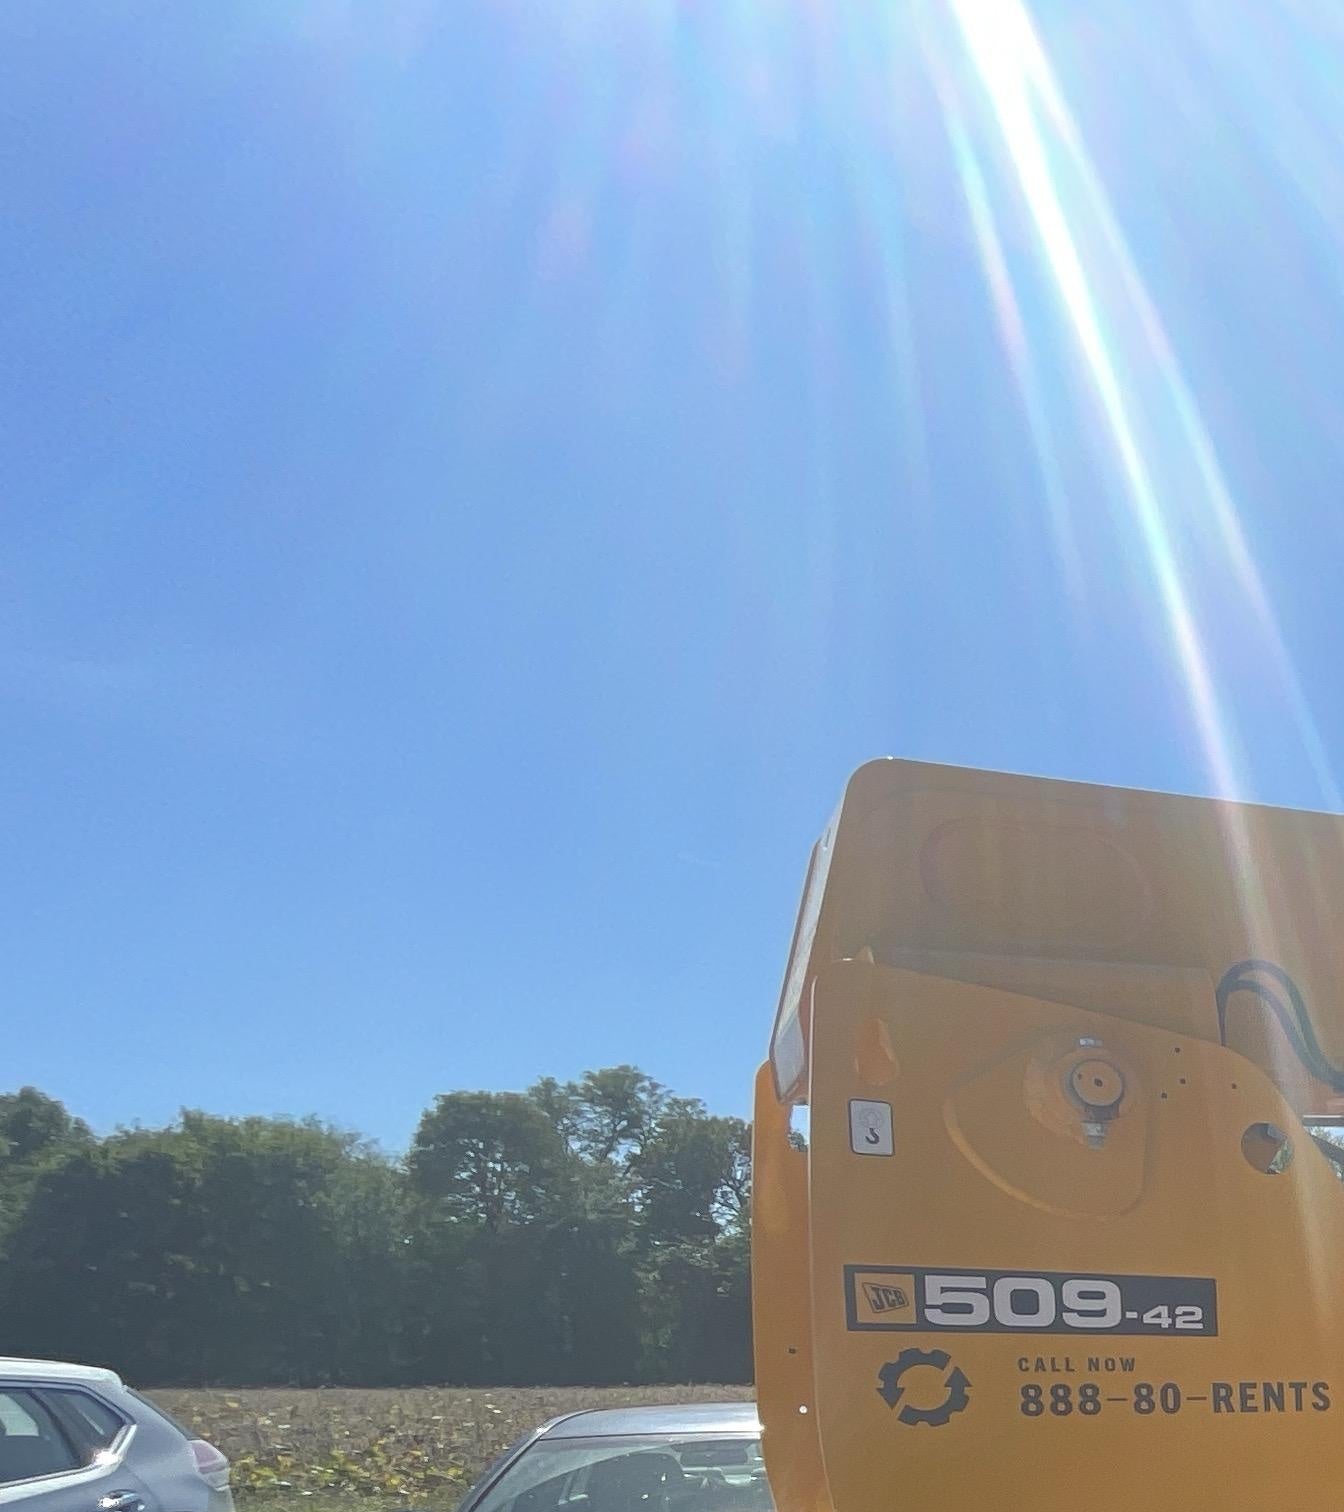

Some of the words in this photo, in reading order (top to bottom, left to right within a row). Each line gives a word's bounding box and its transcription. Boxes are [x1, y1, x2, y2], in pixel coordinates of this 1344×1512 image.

[1018, 1357, 1075, 1372] CALL
[1088, 1357, 1136, 1372] NOW
[1020, 1381, 1332, 1417] 888-80-RENTS
